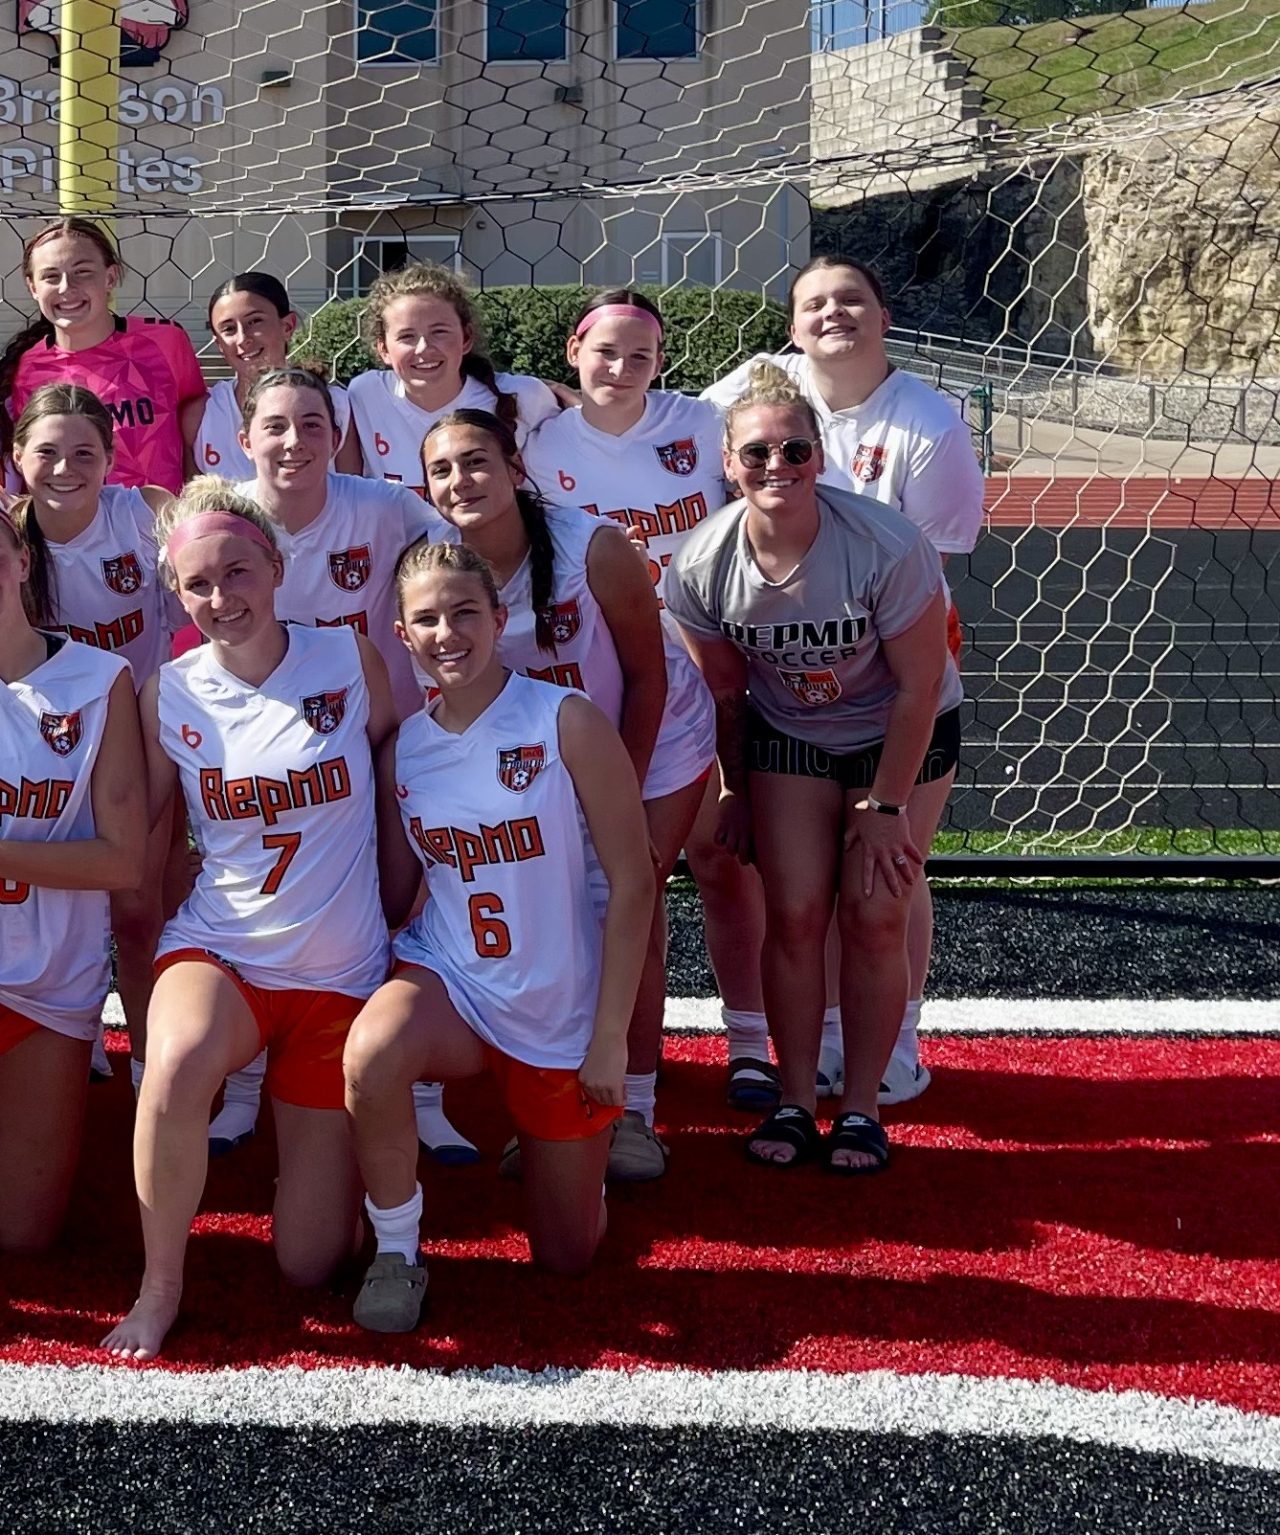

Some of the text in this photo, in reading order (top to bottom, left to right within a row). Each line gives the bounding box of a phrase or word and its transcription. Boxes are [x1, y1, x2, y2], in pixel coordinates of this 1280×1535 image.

[1, 148, 203, 194] Pites
[722, 616, 867, 650] REPMO
[260, 831, 302, 894] 7
[468, 892, 511, 958] 6
